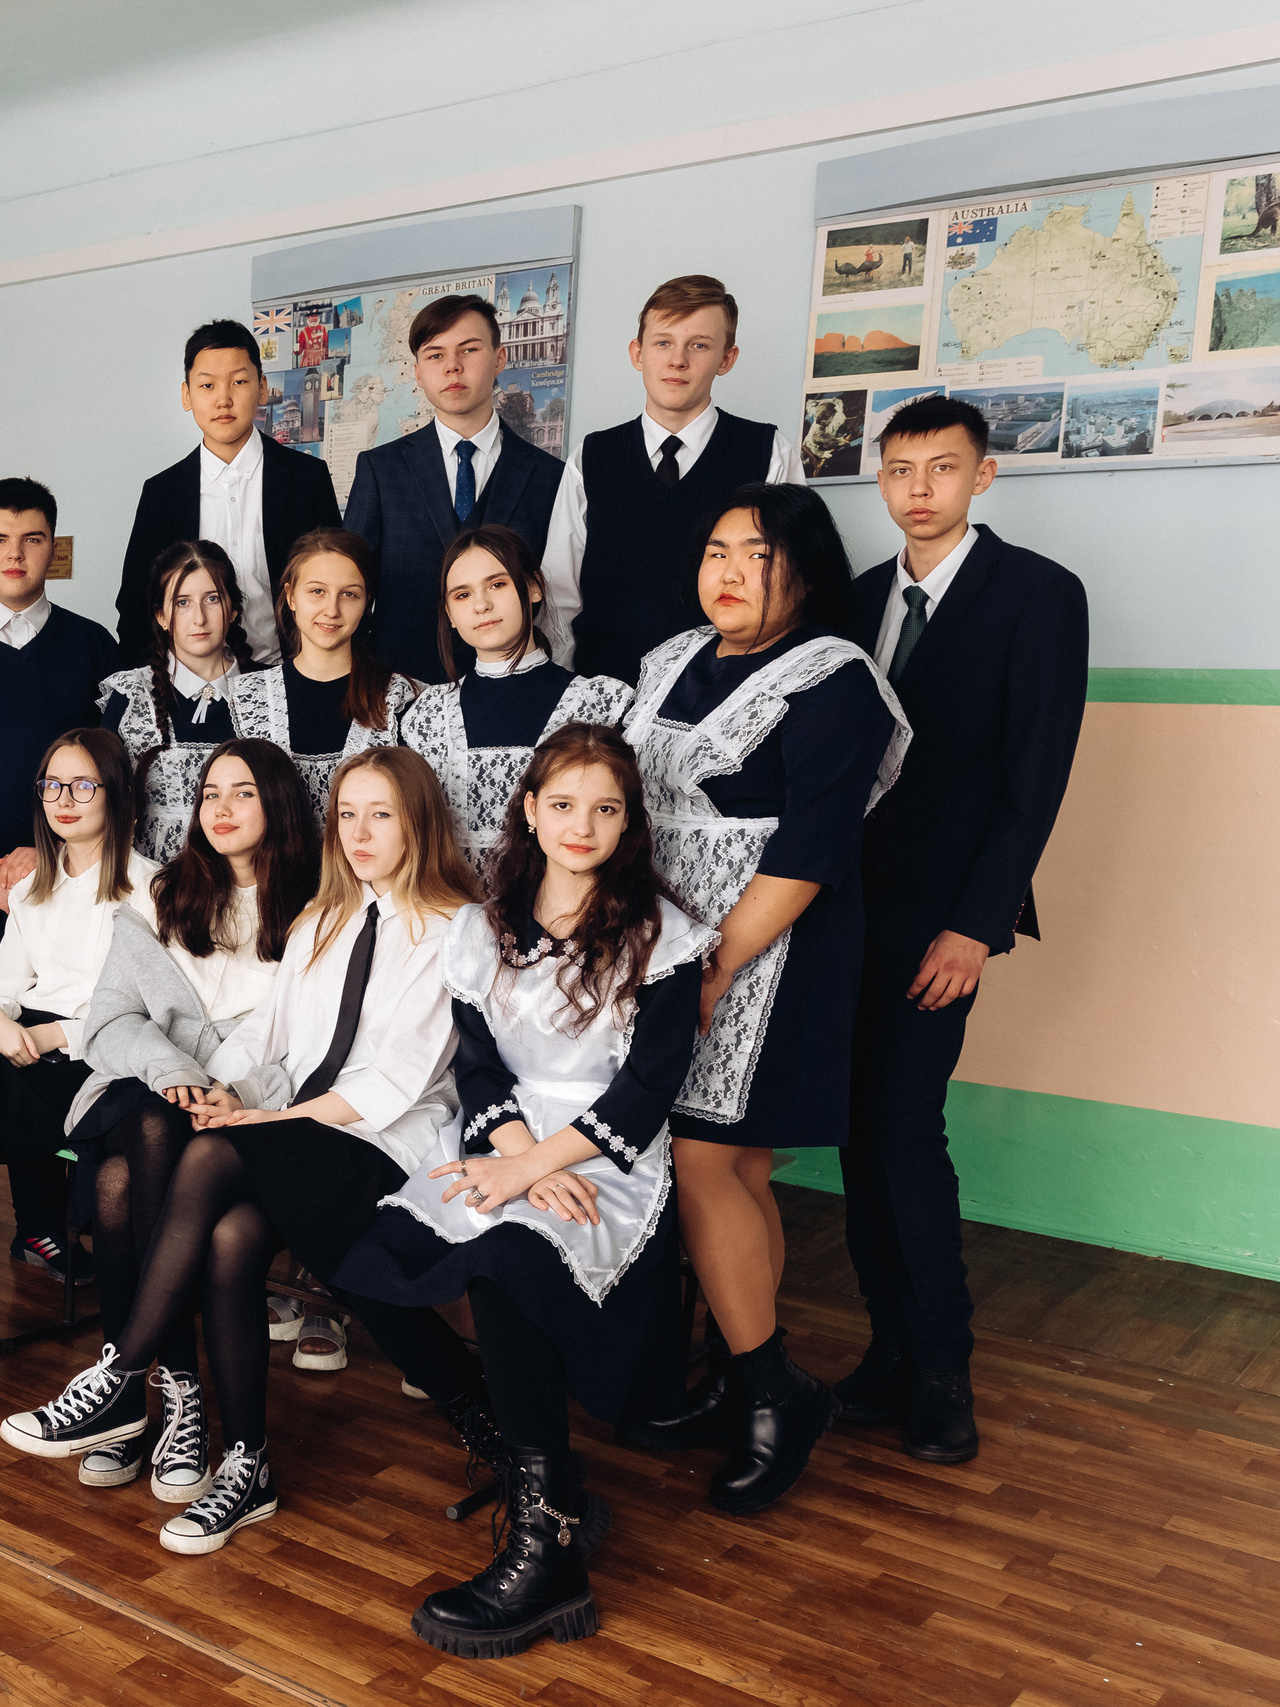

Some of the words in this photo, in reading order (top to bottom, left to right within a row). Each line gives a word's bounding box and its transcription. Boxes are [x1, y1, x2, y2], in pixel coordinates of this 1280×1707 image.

[951, 202, 1028, 221] AUSTRALIA
[422, 284, 451, 296] GREAT
[455, 277, 494, 291] BRITAIN
[531, 369, 565, 379] Cambridge
[531, 378, 565, 387] Кембридж
